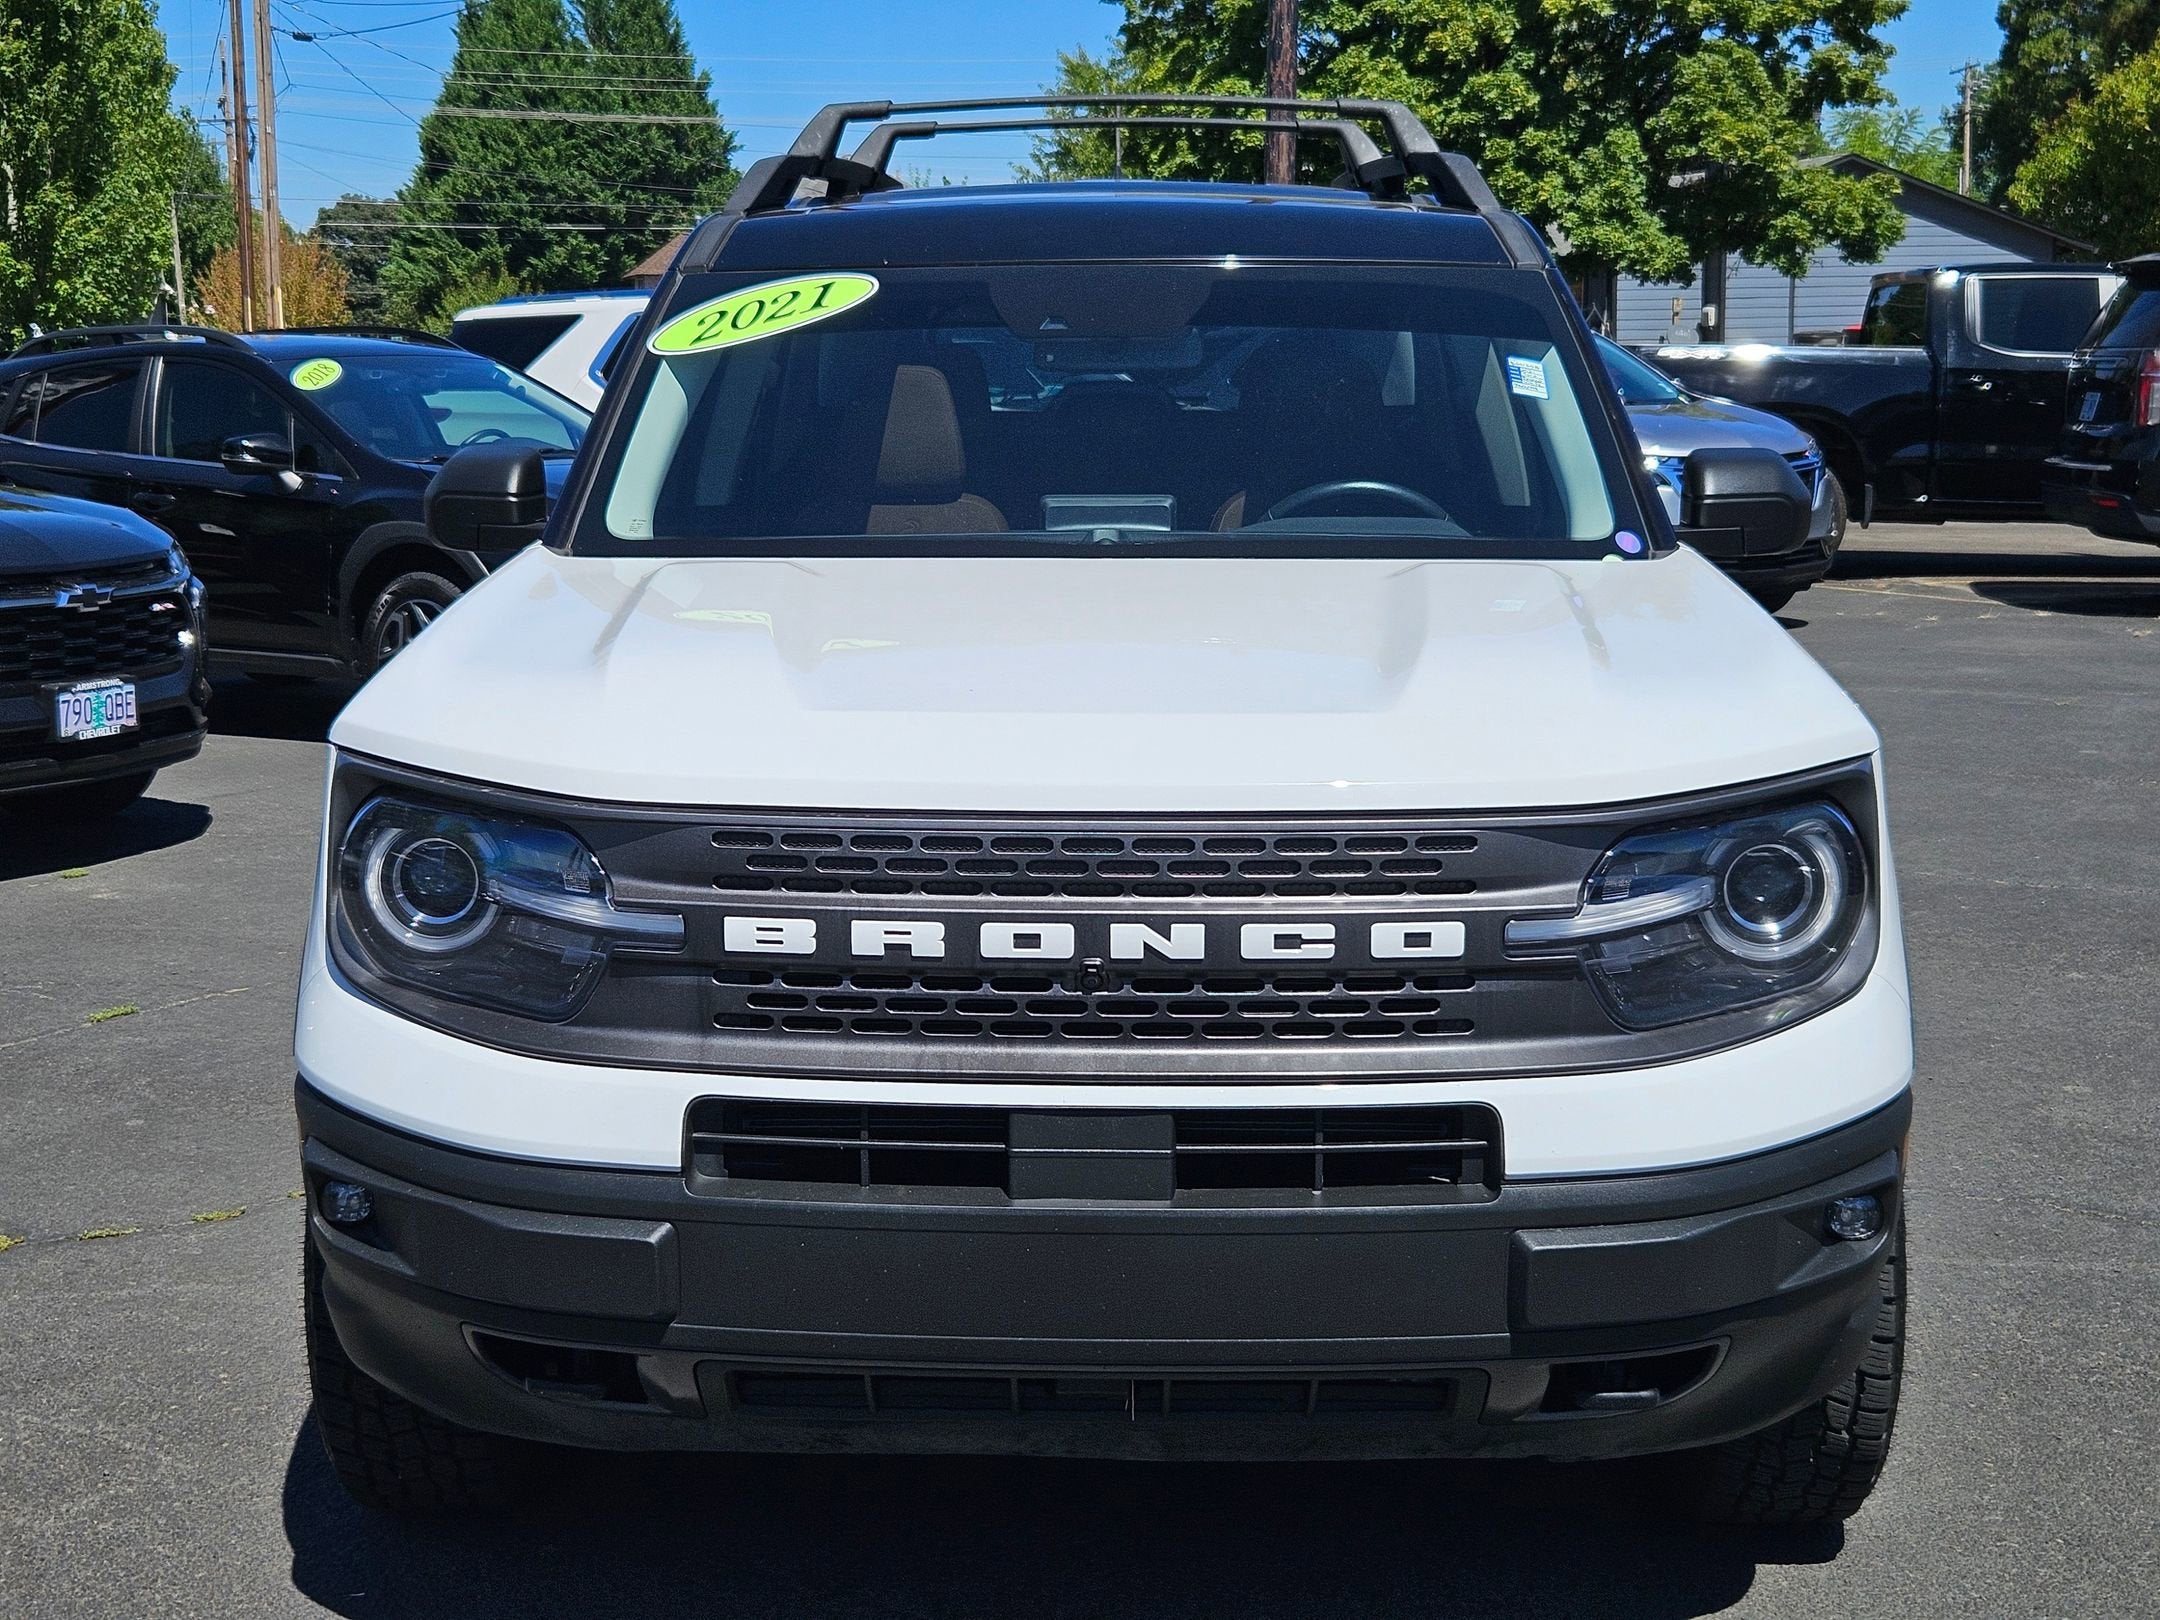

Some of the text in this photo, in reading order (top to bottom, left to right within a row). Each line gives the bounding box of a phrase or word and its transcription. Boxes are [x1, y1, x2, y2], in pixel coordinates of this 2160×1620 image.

[689, 281, 837, 346] 2021
[302, 363, 336, 387] 2018
[76, 679, 121, 691] ARMSTRONG
[60, 690, 135, 728] 790 QBE
[79, 725, 121, 740] CHEVROLET
[723, 916, 1466, 960] BRONCO
